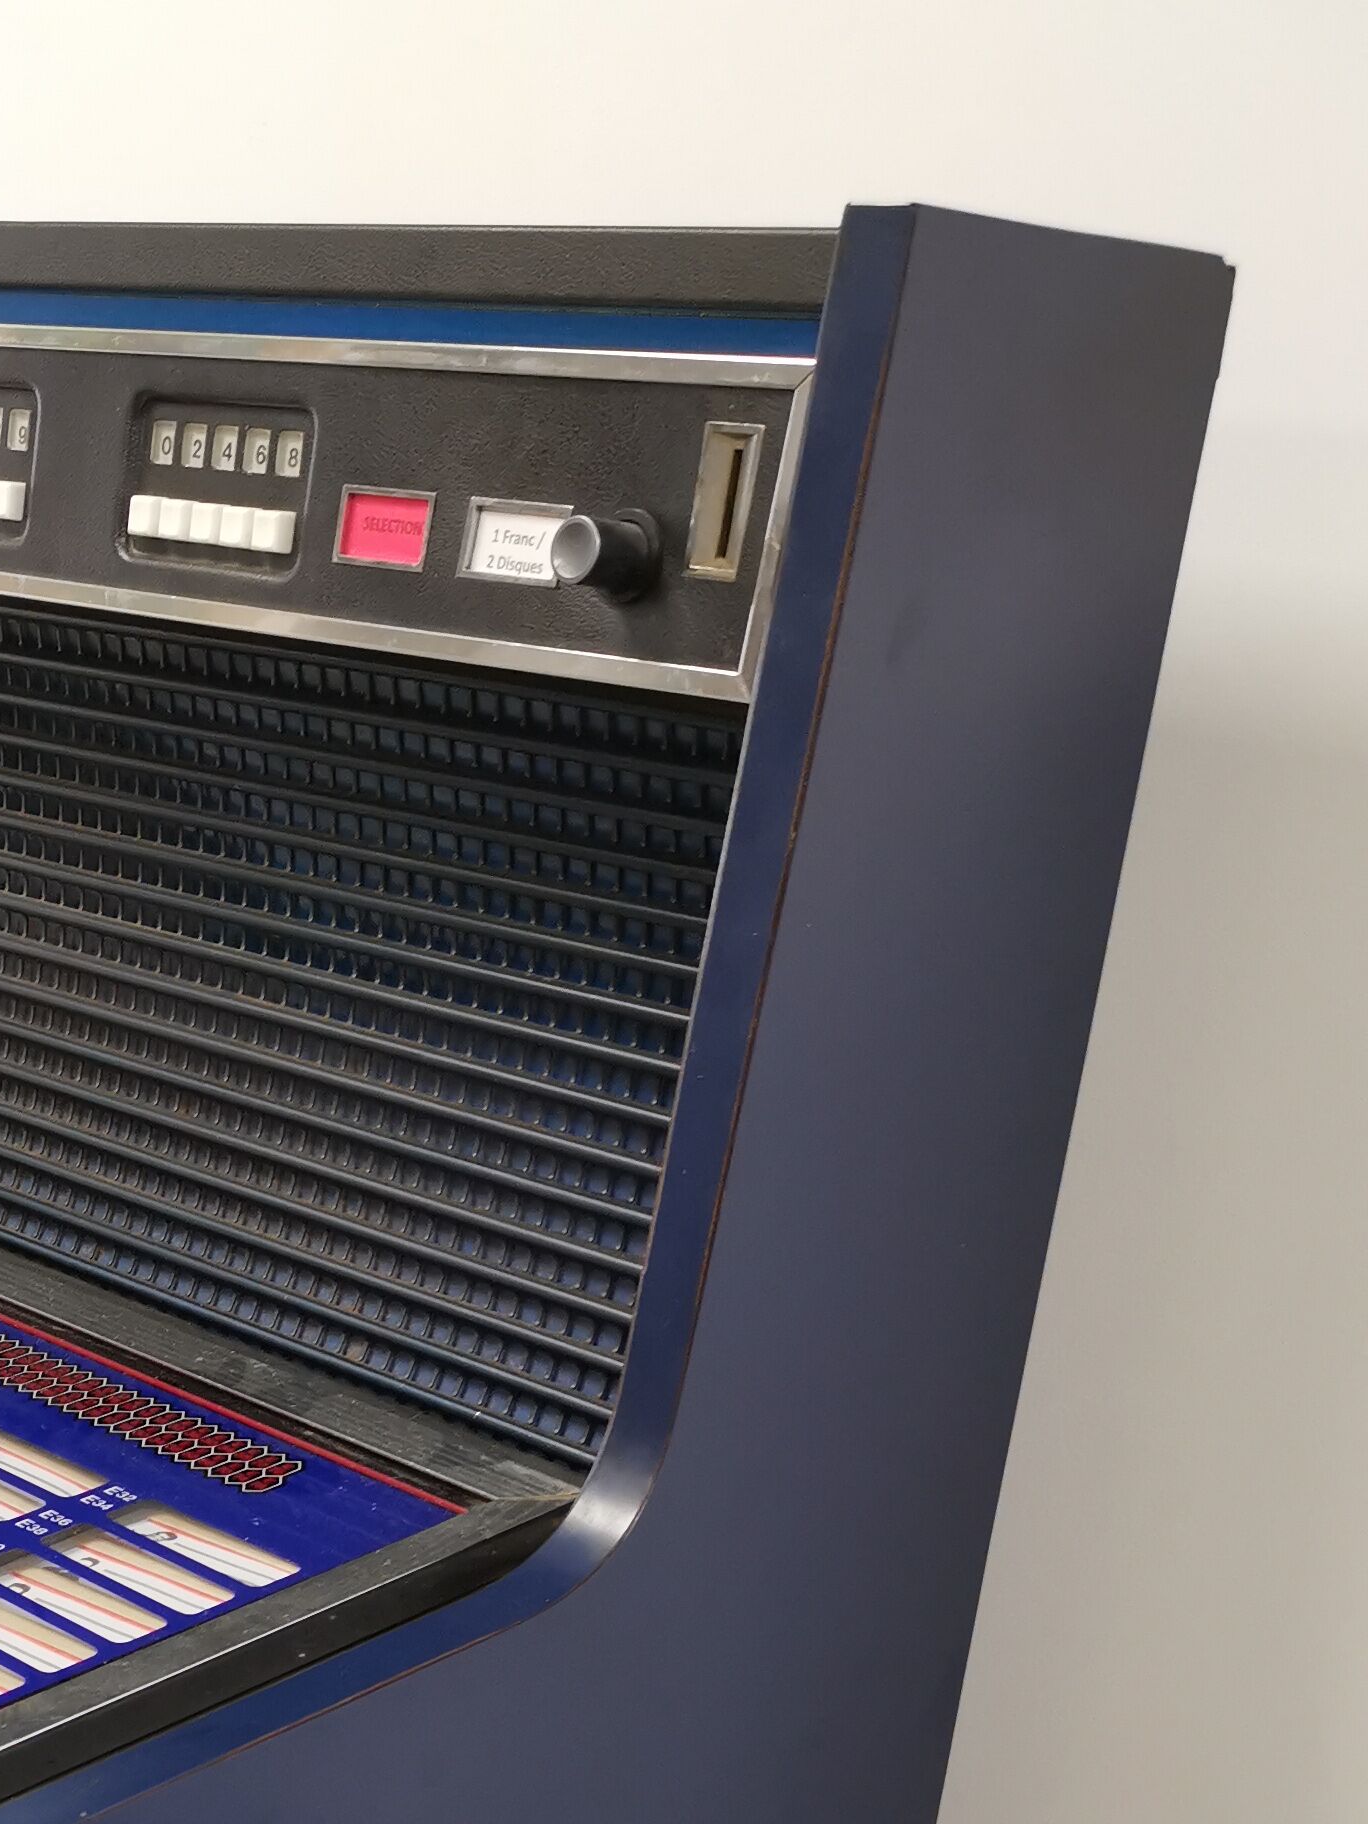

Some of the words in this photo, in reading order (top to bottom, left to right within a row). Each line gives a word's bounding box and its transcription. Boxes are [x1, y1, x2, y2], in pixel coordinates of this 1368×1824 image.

[18, 426, 28, 444] 9
[161, 436, 172, 455] 0
[192, 439, 202, 458] 2
[222, 442, 232, 461] 4
[256, 445, 266, 465] 6
[287, 447, 299, 467] 8
[361, 515, 424, 537] SELECTION
[491, 528, 499, 543] 1
[501, 529, 535, 547] Franc
[486, 554, 494, 569] 2
[496, 555, 544, 575] Disques
[79, 1494, 114, 1511] E34
[102, 1485, 138, 1503] E32
[14, 1517, 49, 1536] E38
[38, 1509, 73, 1527] E36
